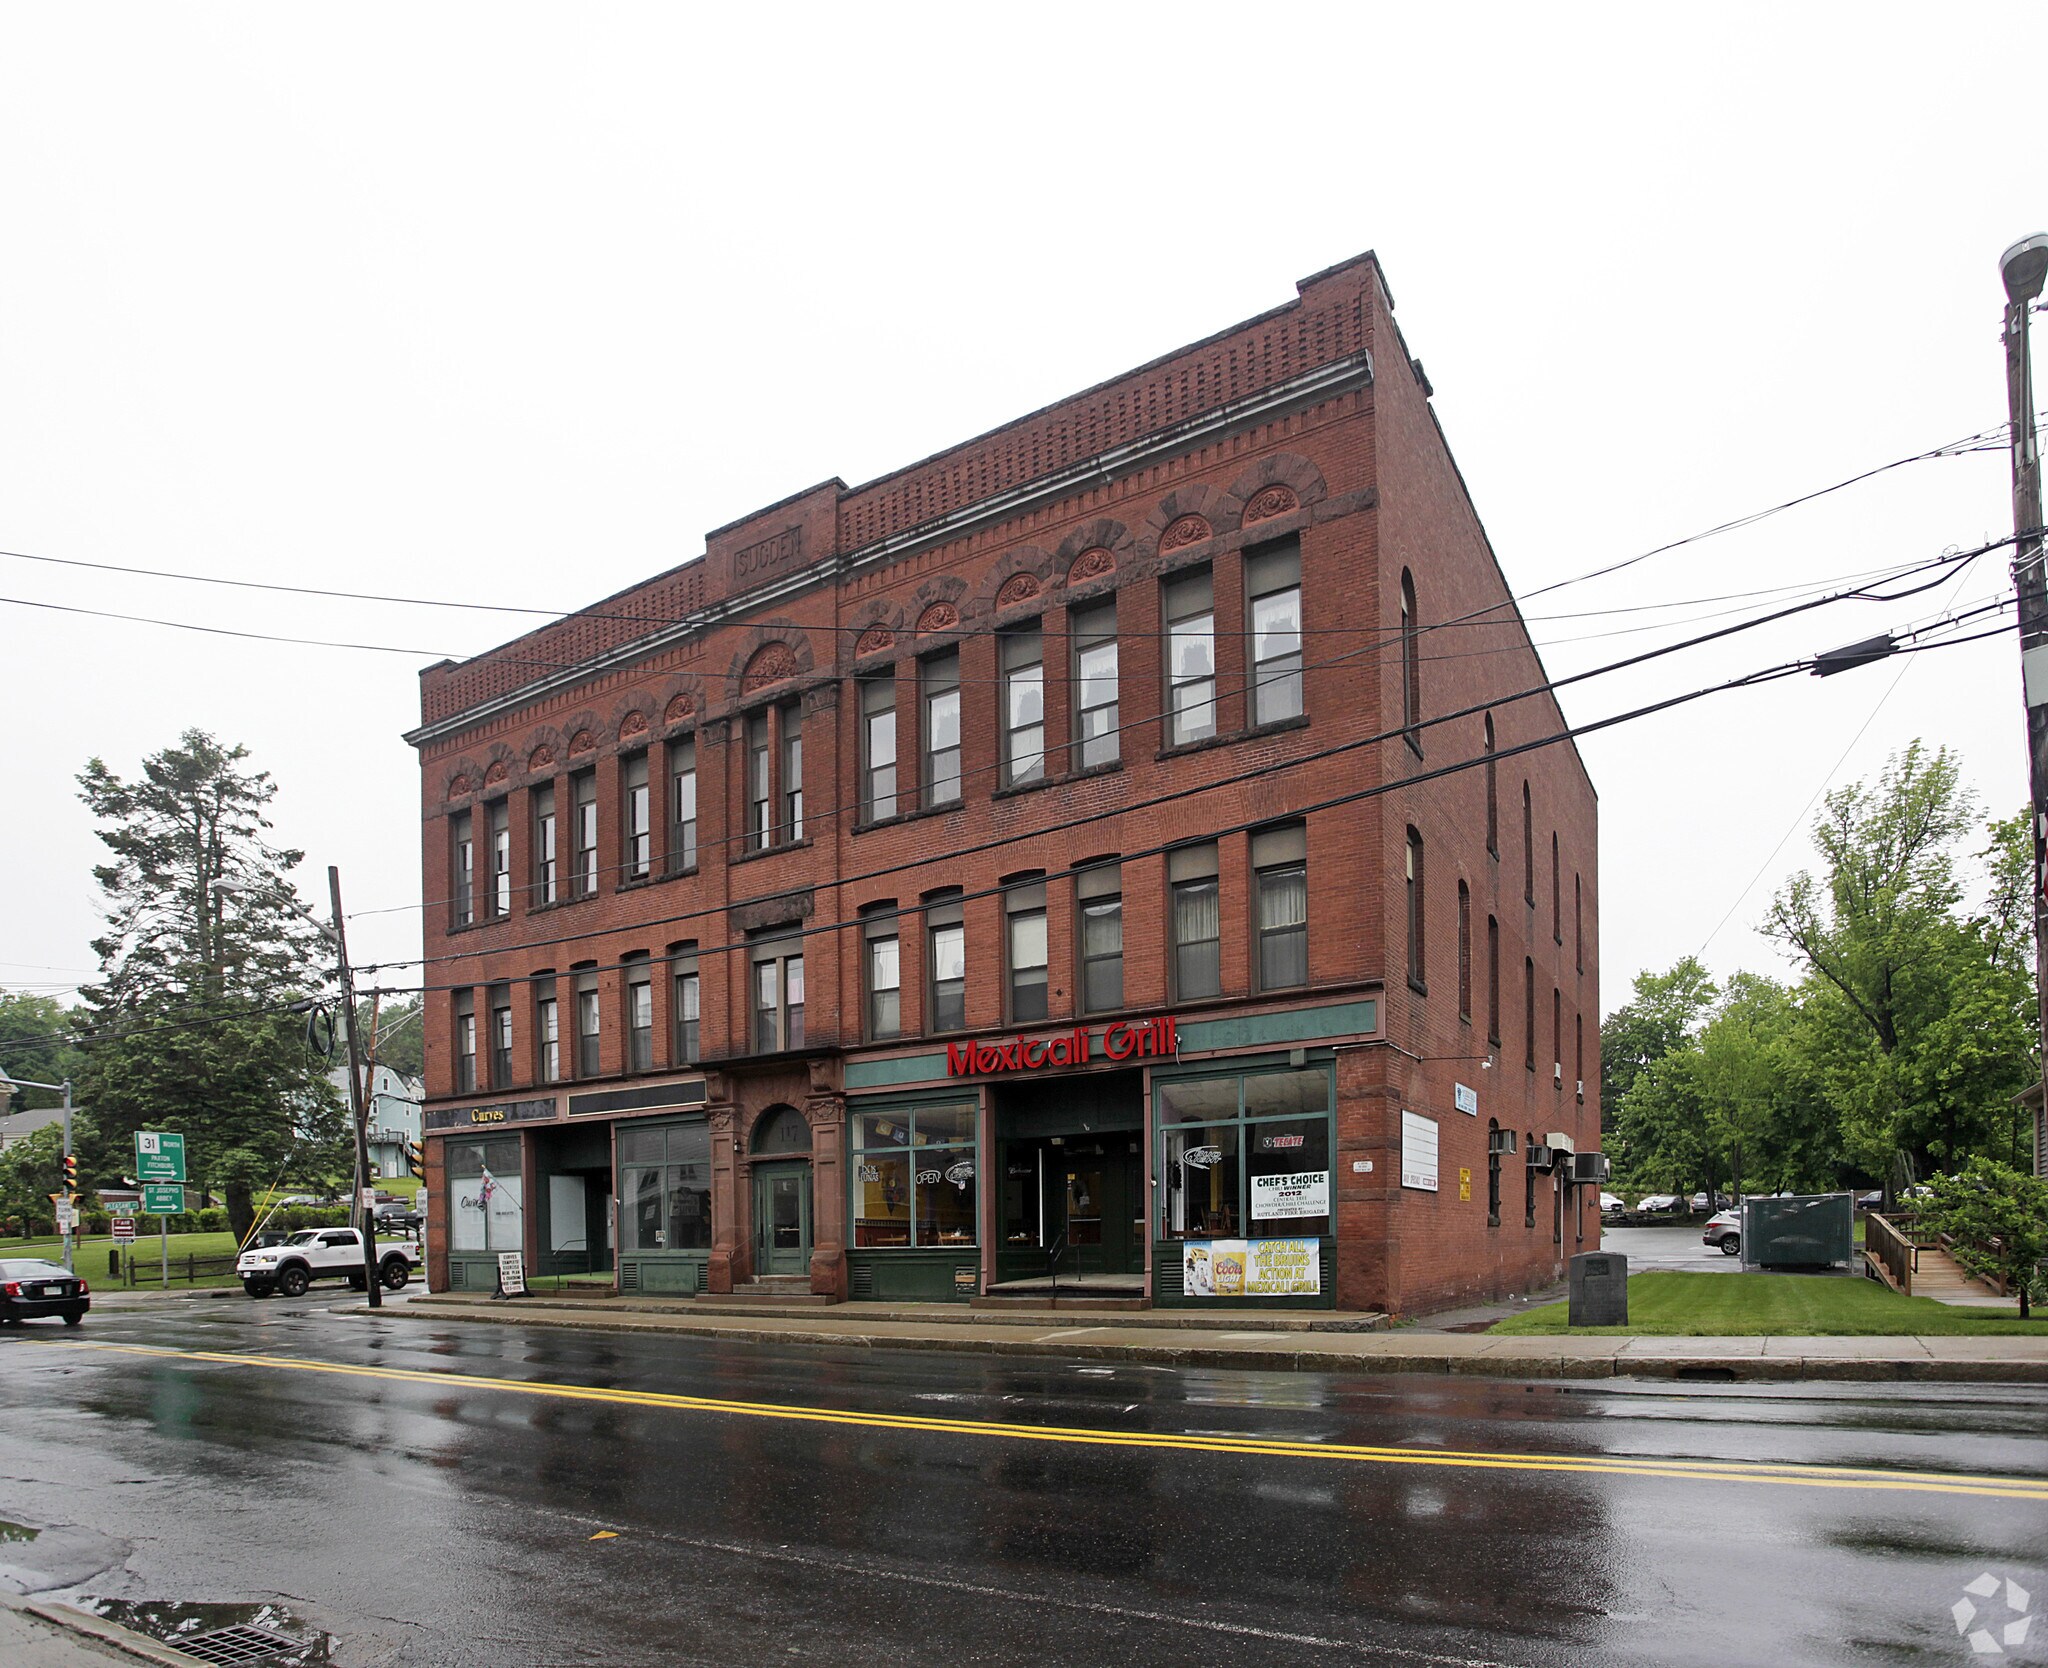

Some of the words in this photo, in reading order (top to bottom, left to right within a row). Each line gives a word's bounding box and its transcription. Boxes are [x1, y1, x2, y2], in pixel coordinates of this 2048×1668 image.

[947, 1027, 1089, 1076] Mexicali
[1103, 1016, 1176, 1061] Grill
[471, 1109, 504, 1122] Curves
[144, 1138, 155, 1149] 31
[1273, 1136, 1304, 1147] TECATE
[916, 1173, 940, 1185] OPEN
[1290, 1174, 1324, 1185] CHOICE
[1257, 1241, 1288, 1253] CATCH
[1289, 1240, 1306, 1253] ALL
[1254, 1255, 1272, 1267] THE
[1273, 1253, 1310, 1267] BRUINS
[1216, 1261, 1243, 1275] Coors
[1258, 1268, 1292, 1280] ACTION
[1294, 1267, 1306, 1280] AT
[1216, 1274, 1242, 1283] LIGHT
[1247, 1281, 1290, 1294] MEXICALI
[1291, 1280, 1319, 1293] GRILL
